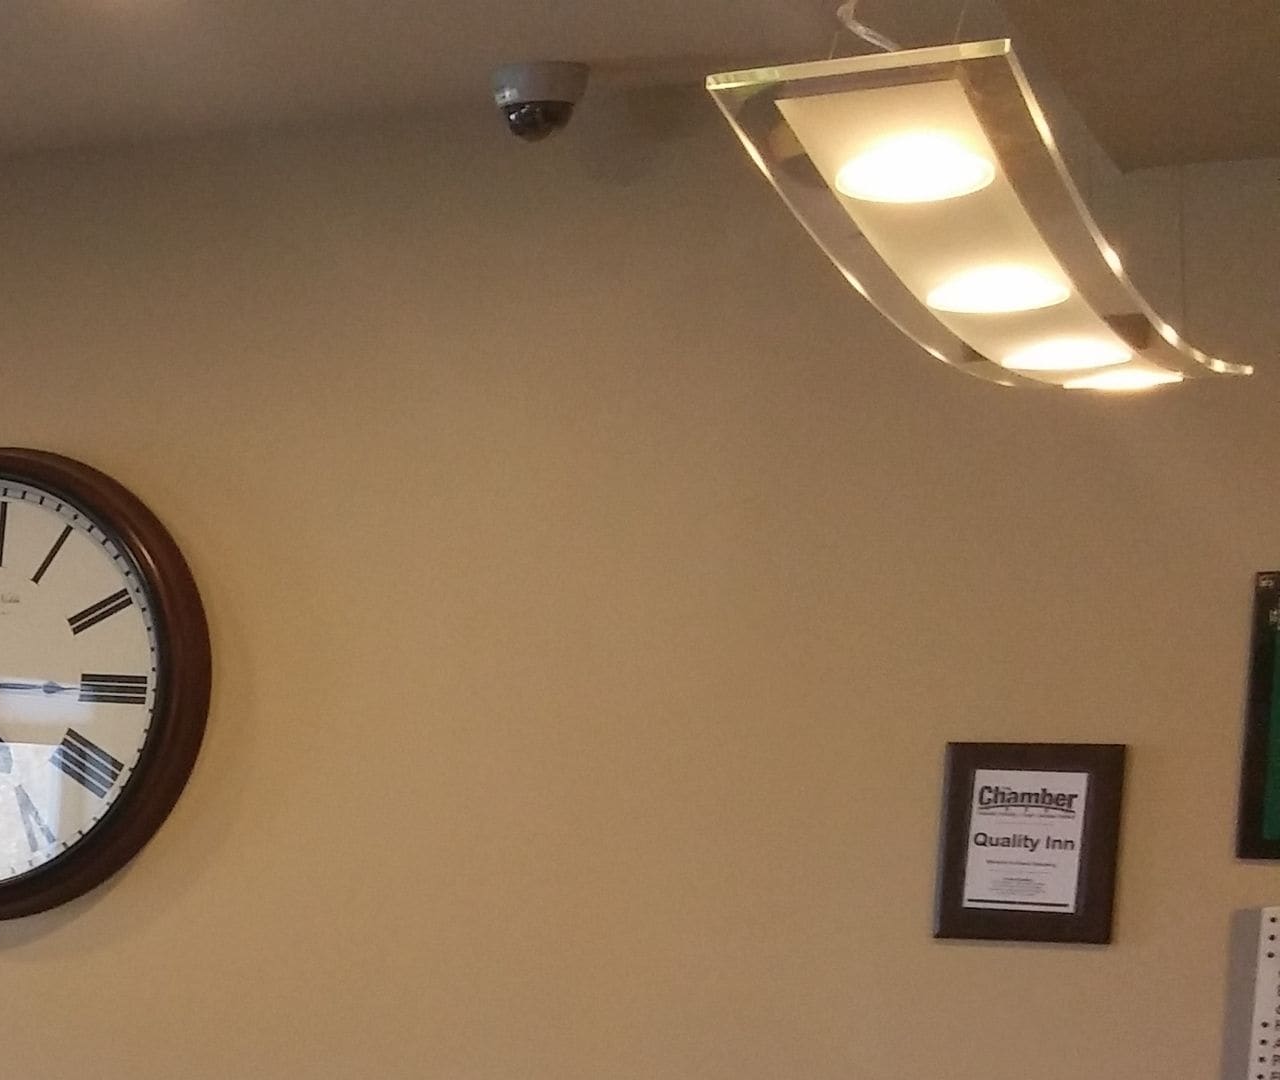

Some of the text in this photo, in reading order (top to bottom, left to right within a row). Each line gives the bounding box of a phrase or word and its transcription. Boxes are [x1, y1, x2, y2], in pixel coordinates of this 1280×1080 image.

[31, 525, 74, 585] I
[67, 587, 134, 635] II
[77, 673, 148, 704] III
[978, 785, 1079, 809] Chamber
[973, 832, 1076, 852] Quality Inn
